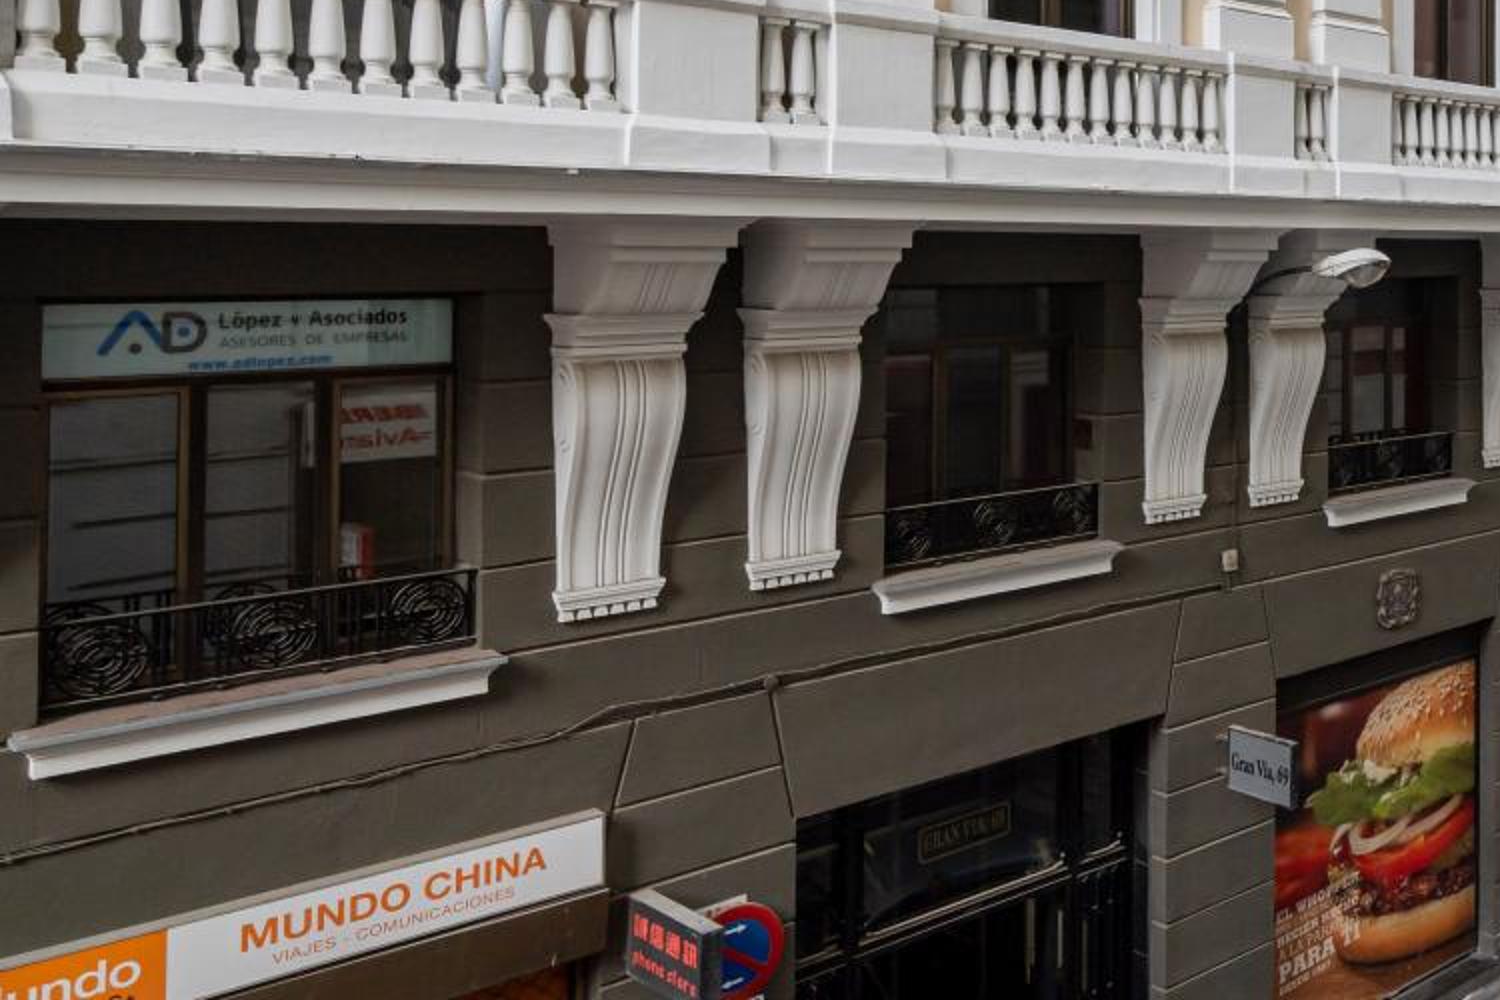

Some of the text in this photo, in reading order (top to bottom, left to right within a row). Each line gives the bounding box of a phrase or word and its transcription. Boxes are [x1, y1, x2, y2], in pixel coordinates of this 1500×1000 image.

[218, 311, 283, 331] López
[310, 307, 408, 327] Asociados
[1231, 751, 1255, 776] Gran
[239, 846, 548, 953] MUNDO CHINA
[271, 934, 337, 966] VIAJES
[355, 885, 516, 943] COMUNICACIONES
[1279, 935, 1337, 985] PARA
